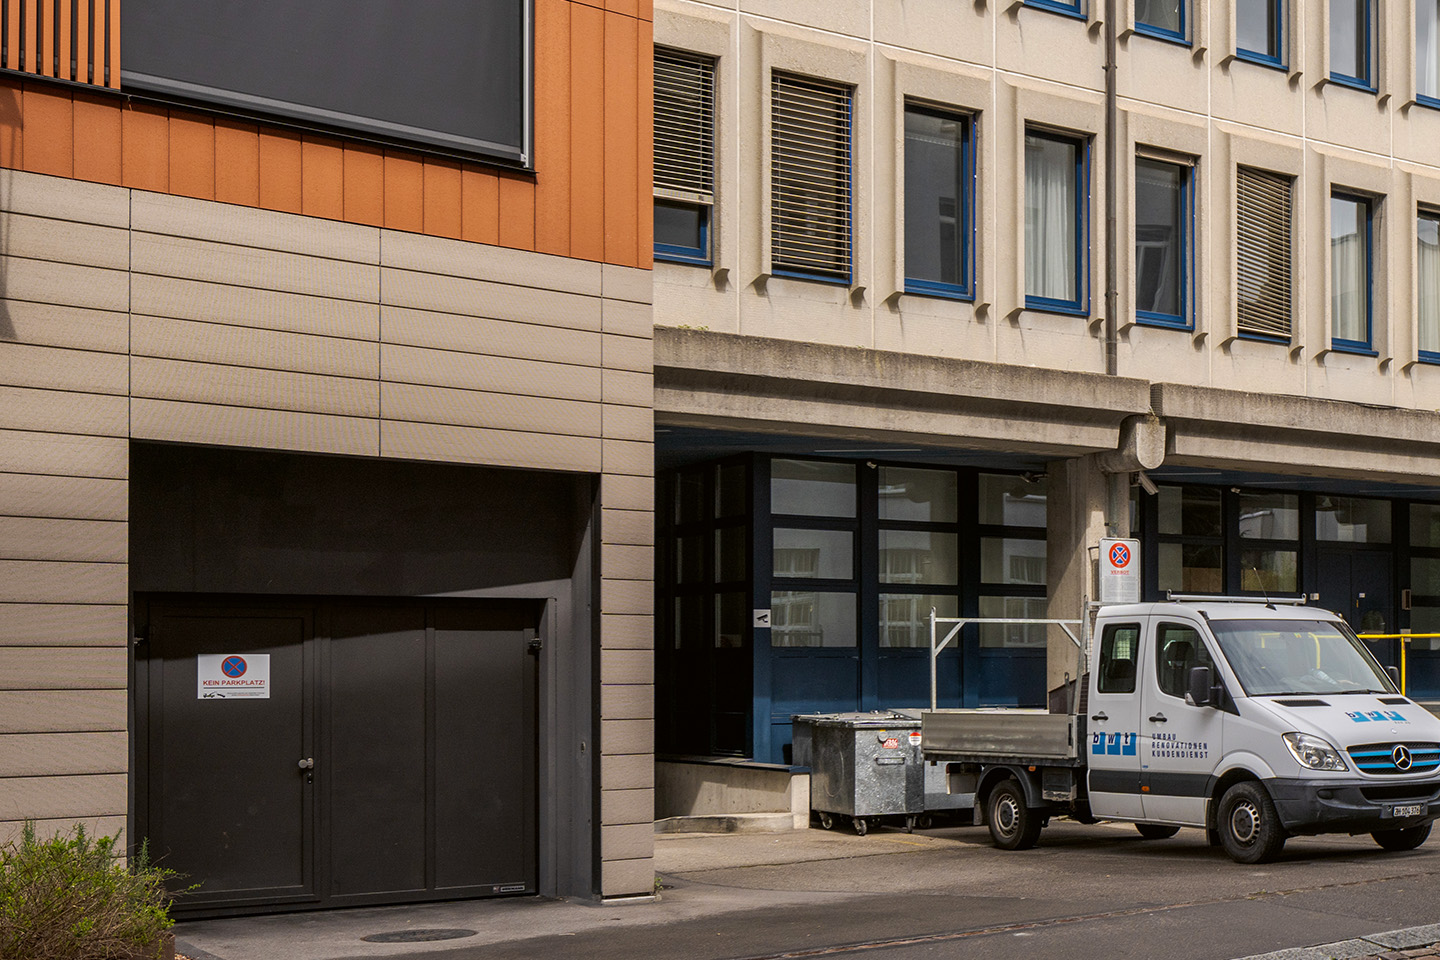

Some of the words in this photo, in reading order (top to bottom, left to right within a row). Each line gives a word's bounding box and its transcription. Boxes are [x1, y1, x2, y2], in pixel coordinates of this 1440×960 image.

[1151, 733, 1177, 741] UMBAU
[1151, 742, 1208, 750] RENOVATIONEN
[1151, 750, 1209, 759] KUNDENDIENST
